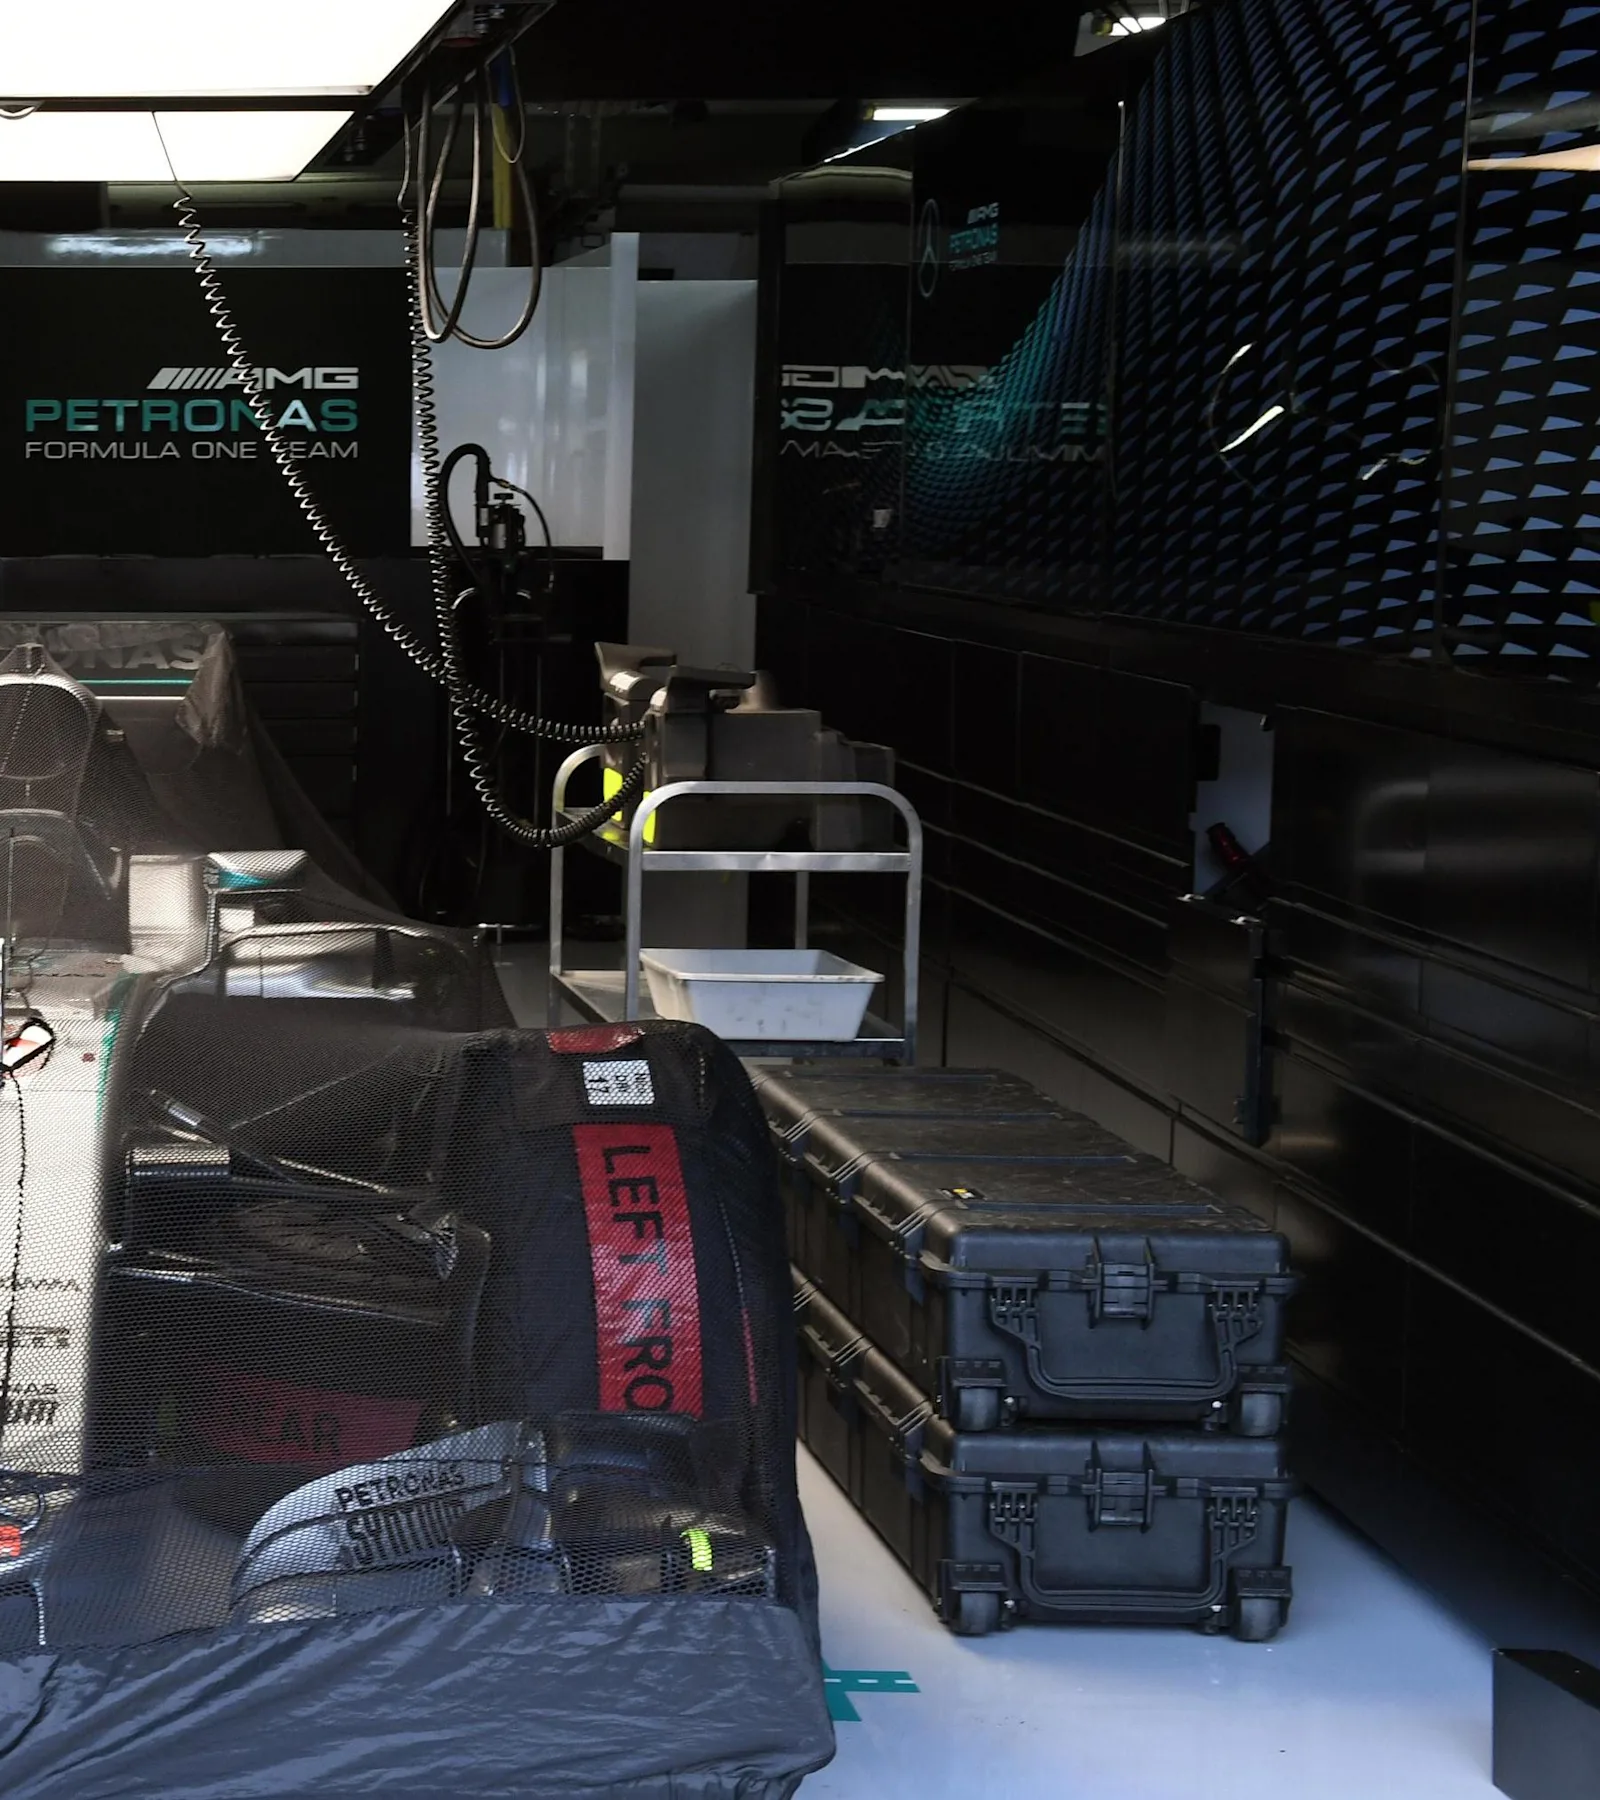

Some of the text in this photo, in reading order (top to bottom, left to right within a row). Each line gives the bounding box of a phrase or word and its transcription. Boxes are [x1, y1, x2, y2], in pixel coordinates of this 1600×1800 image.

[213, 367, 360, 390] AMG
[25, 399, 359, 432] PETRONAS
[25, 441, 181, 459] FORMULA
[191, 441, 259, 459] ONE
[603, 1144, 669, 1277] LEFT
[334, 1469, 466, 1511] PETRONAS
